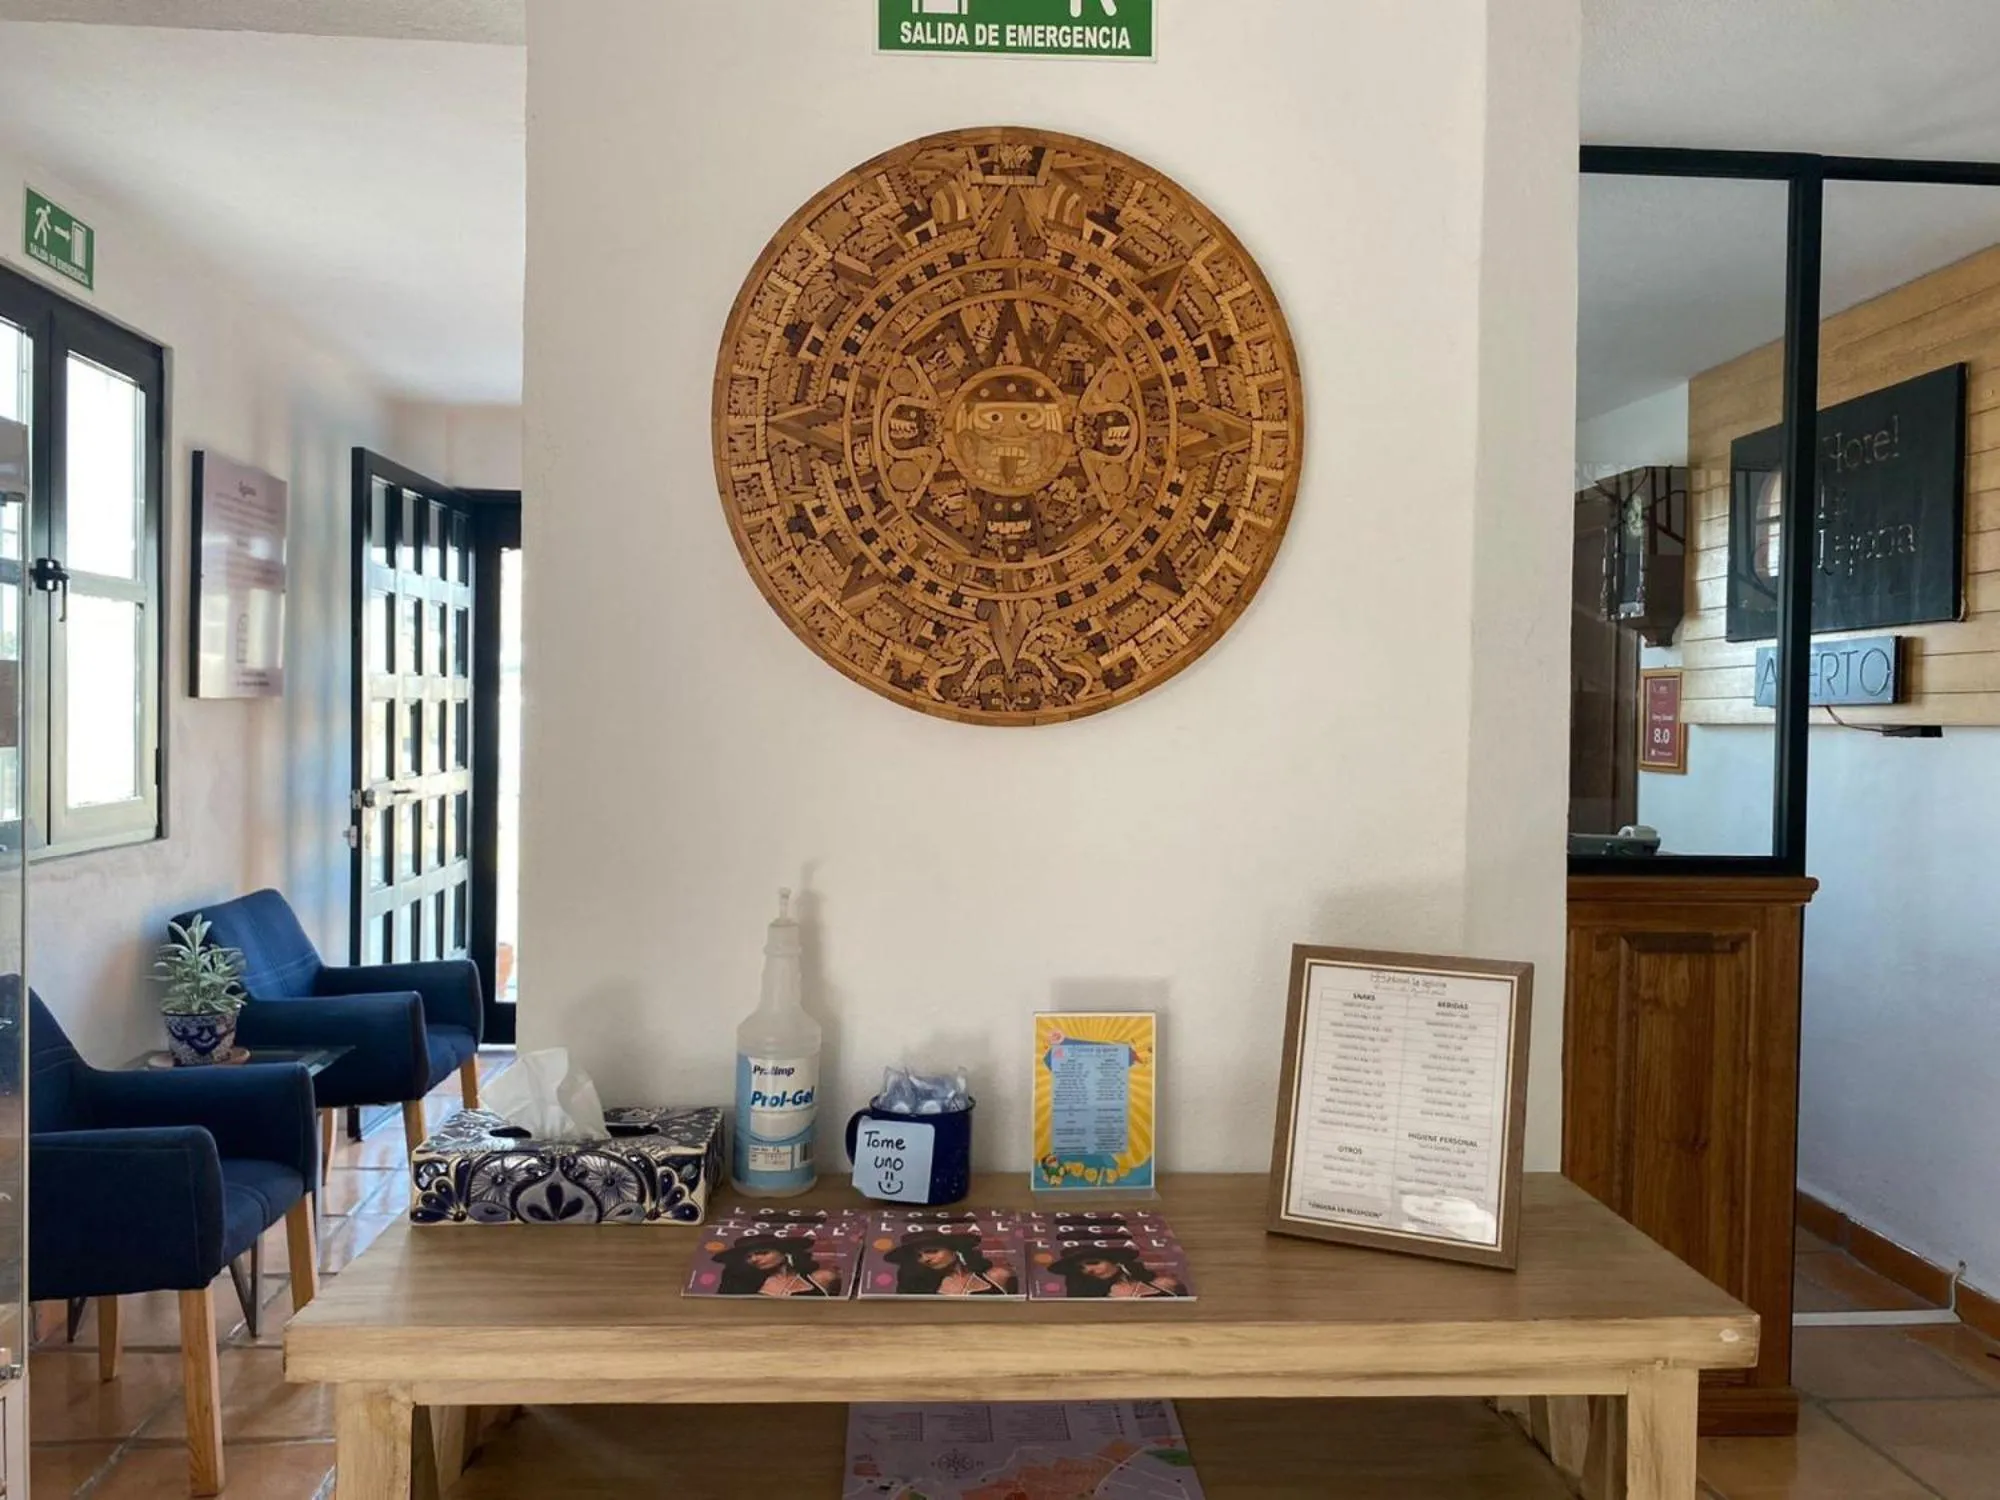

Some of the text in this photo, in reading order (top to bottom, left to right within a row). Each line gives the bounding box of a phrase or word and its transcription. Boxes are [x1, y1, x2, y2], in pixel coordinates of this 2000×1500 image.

[900, 21, 1131, 49] SALIDA DE EMERGENCIA
[1653, 727, 1670, 745] 8.0
[864, 1130, 906, 1150] Tome
[733, 1206, 854, 1217] LOCAL
[882, 1210, 1003, 1218] LOCAL
[1031, 1211, 1151, 1219] LOCAL
[716, 1227, 845, 1238] LOCAL
[880, 1222, 1009, 1233] LOCAL
[1033, 1225, 1157, 1233] LOCAL
[1036, 1239, 1166, 1248] LOCAL
